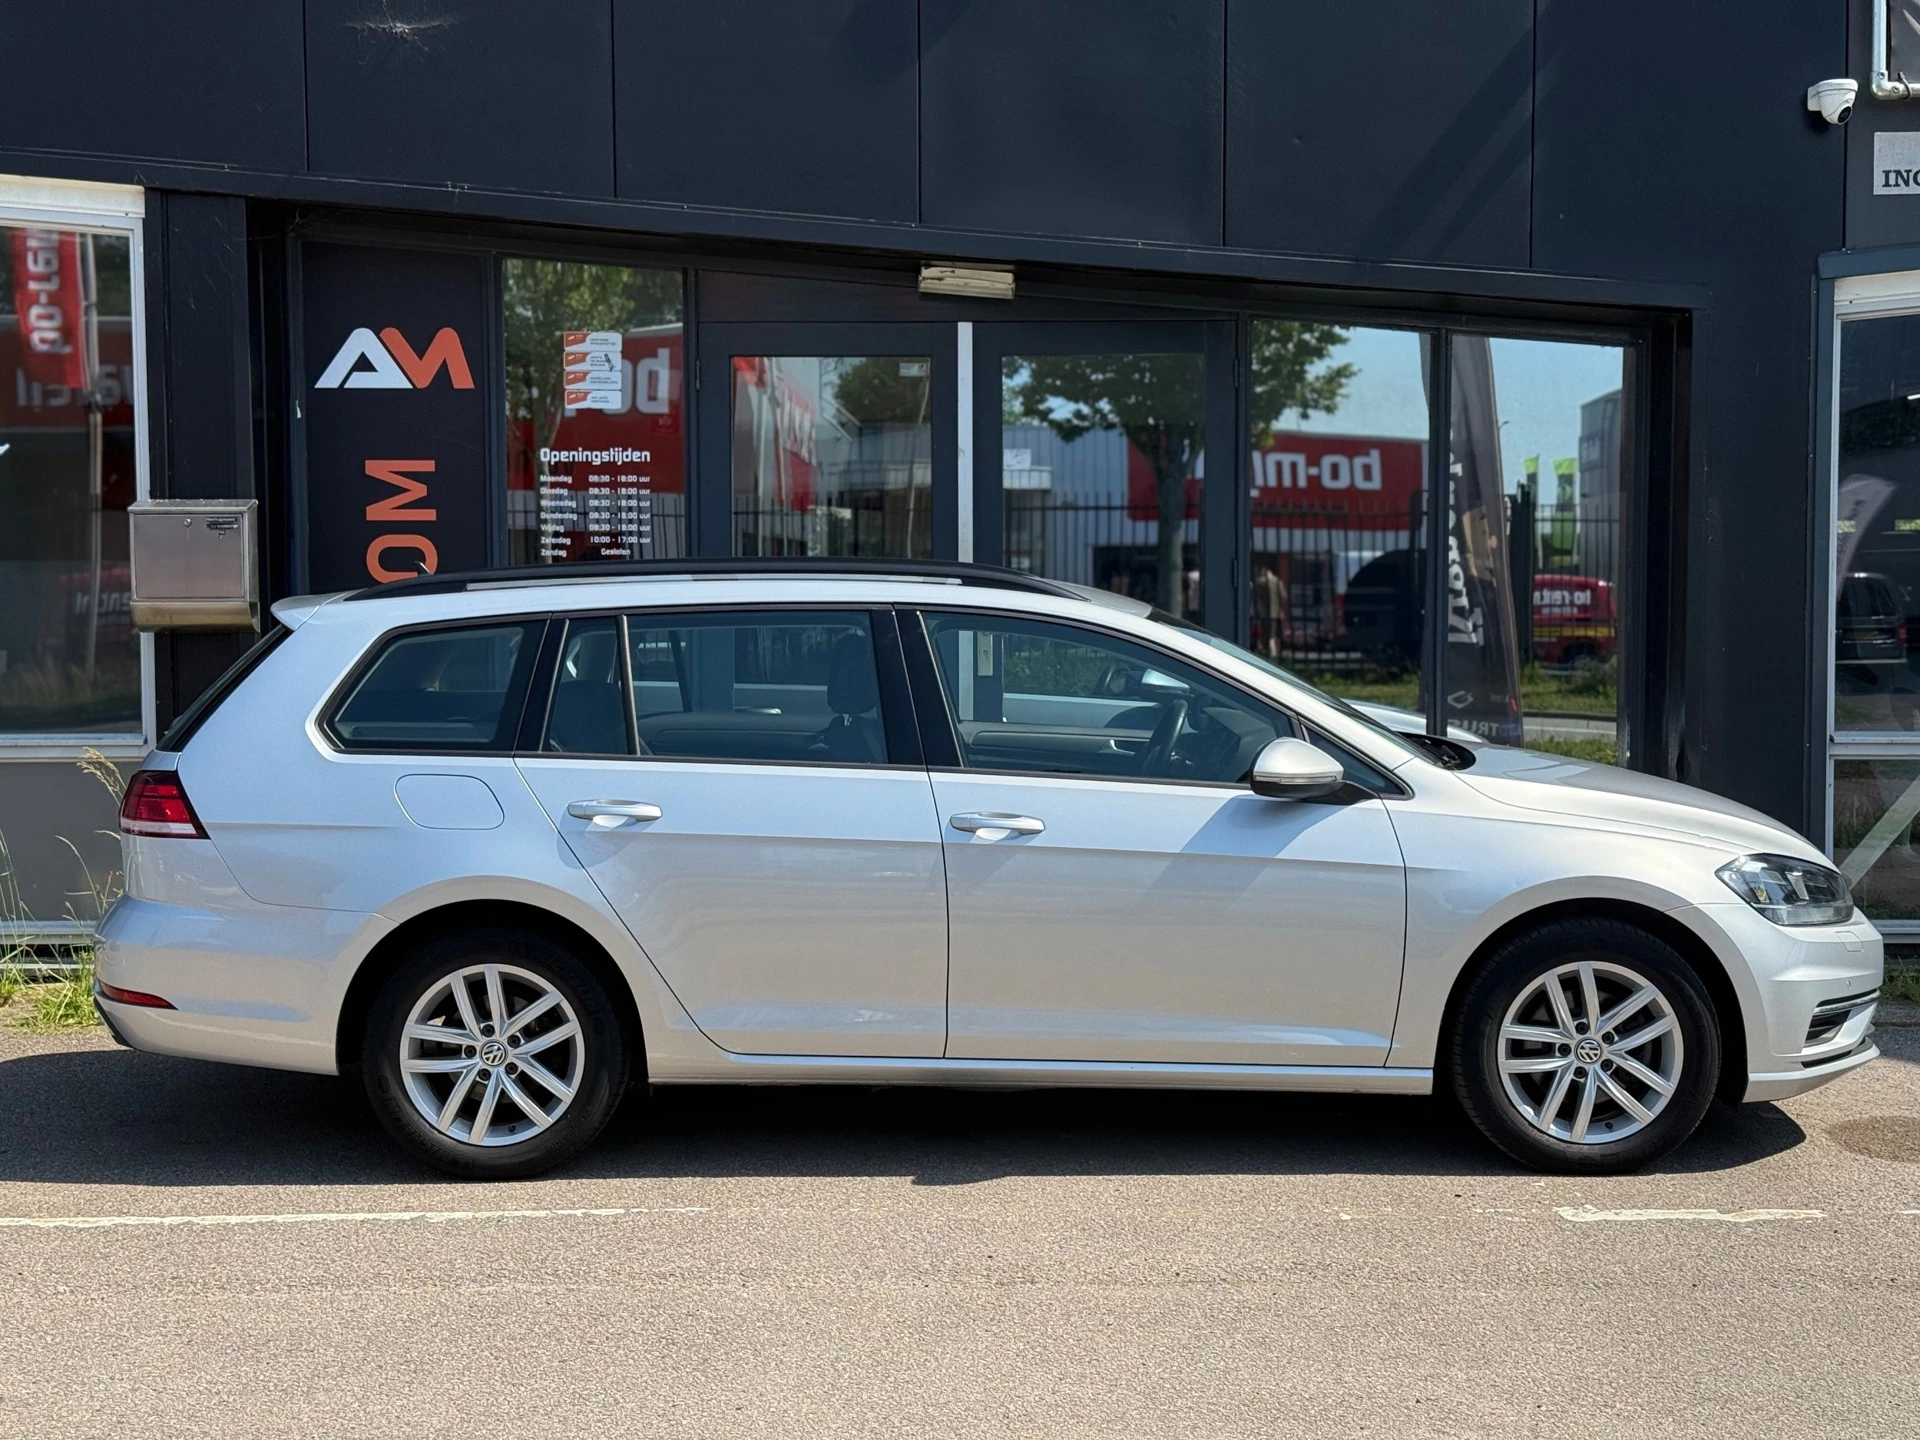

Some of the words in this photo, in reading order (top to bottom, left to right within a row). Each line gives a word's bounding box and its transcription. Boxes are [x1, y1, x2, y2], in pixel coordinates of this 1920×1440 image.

[540, 447, 651, 465] Openingstijden
[540, 475, 573, 484] Maandag
[540, 487, 569, 496] Dinsdag
[540, 500, 577, 508] Woensdag
[540, 512, 578, 521] Donderdag
[540, 524, 565, 533] Vrijdag
[540, 536, 571, 546] Zaterdag
[590, 536, 610, 544] 10:00
[617, 536, 638, 544] 17:00
[540, 549, 567, 558] Zondag
[601, 548, 631, 556] Gesloten
